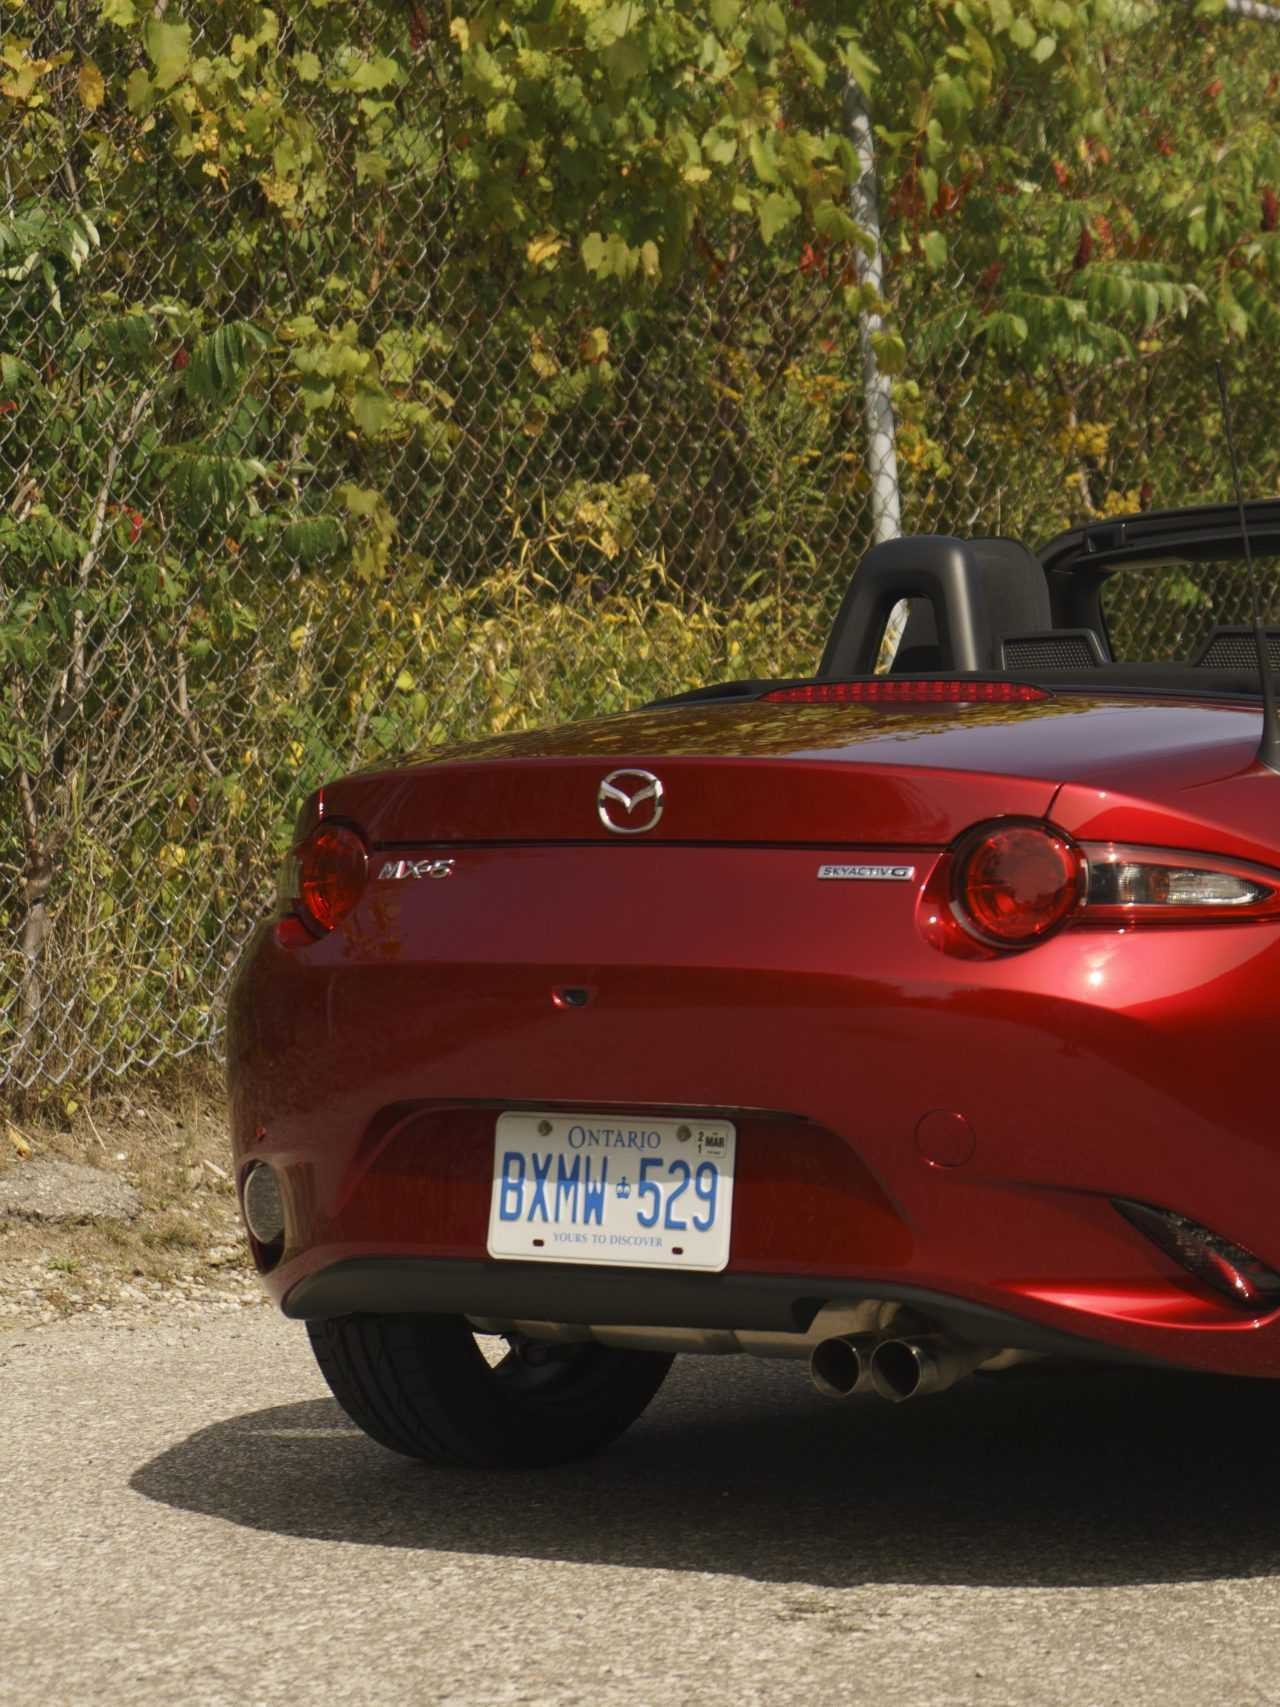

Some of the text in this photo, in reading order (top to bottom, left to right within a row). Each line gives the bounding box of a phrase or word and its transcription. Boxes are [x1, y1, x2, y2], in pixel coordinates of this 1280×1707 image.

[378, 859, 455, 879] MX-5
[567, 1126, 661, 1151] ONTARIO
[499, 1151, 720, 1232] BXMW 529
[553, 1232, 663, 1247] YOURS TO DISCOVER
